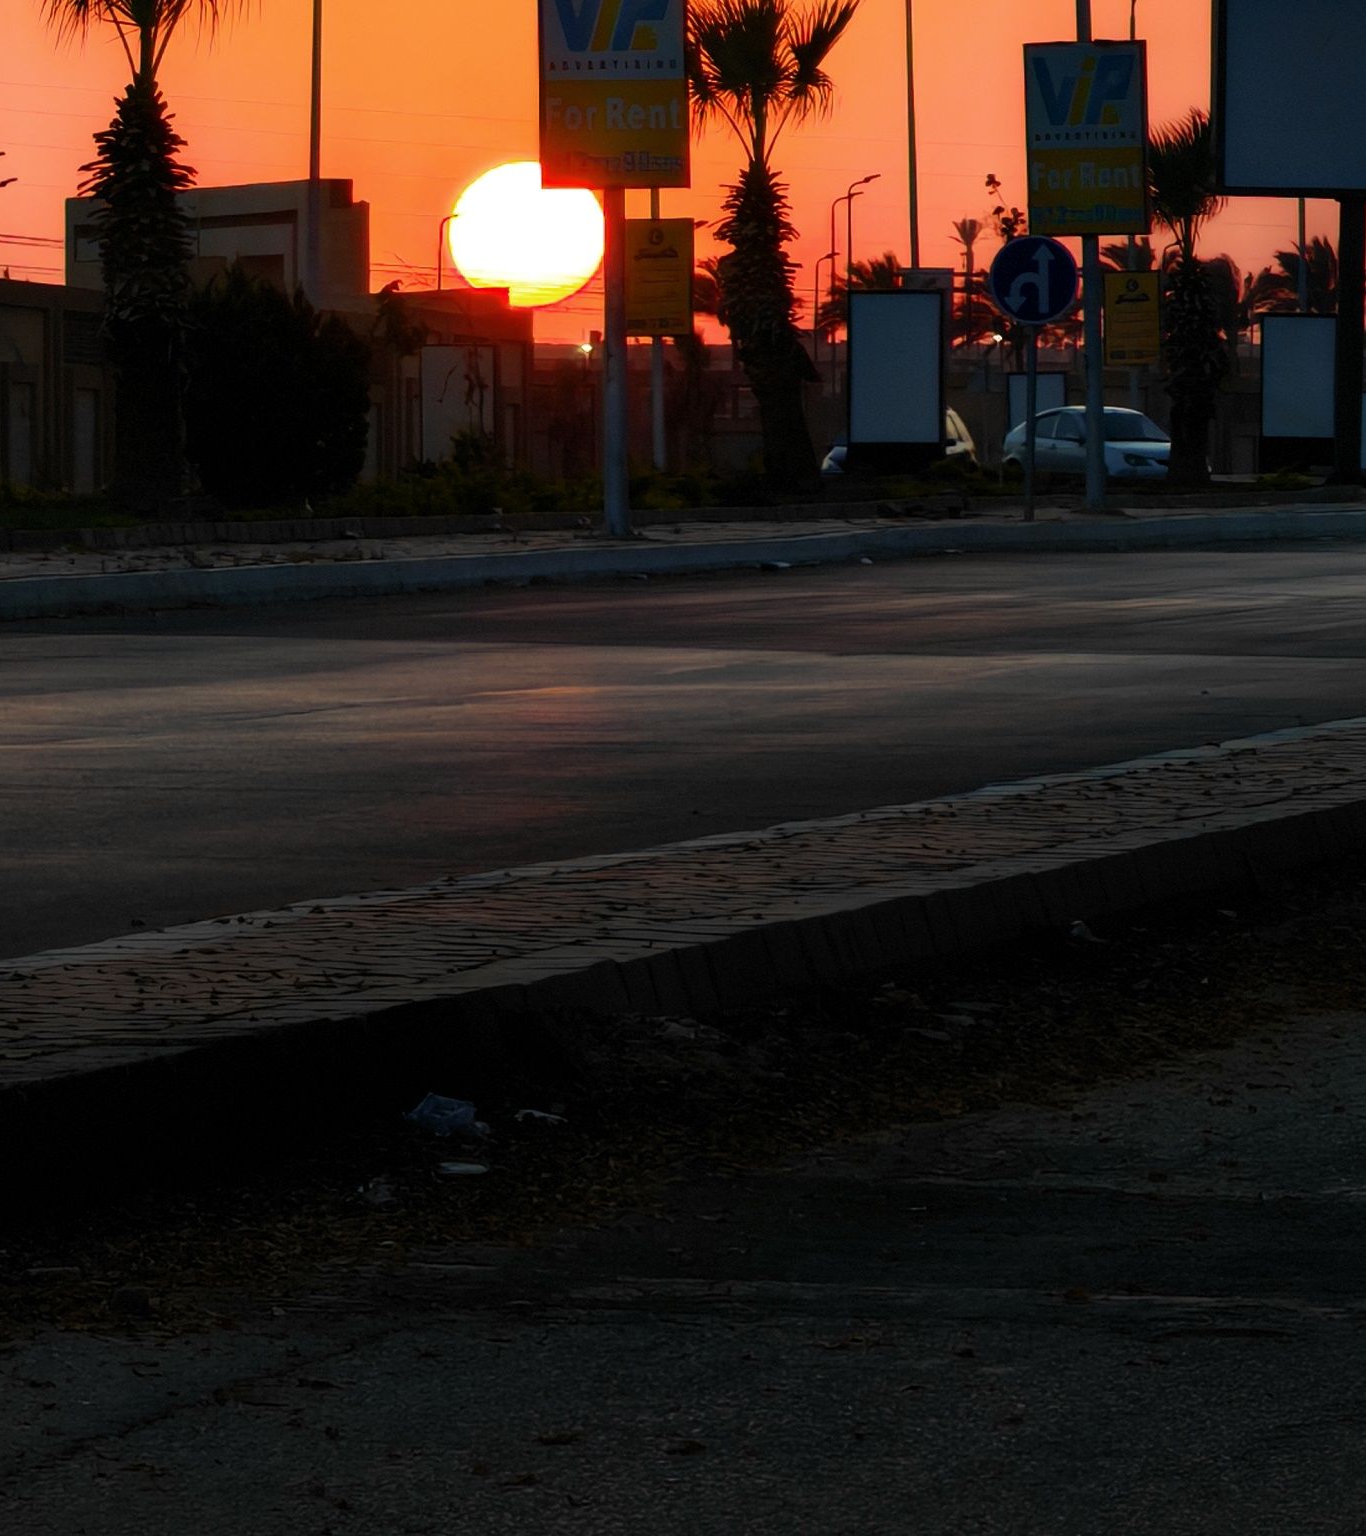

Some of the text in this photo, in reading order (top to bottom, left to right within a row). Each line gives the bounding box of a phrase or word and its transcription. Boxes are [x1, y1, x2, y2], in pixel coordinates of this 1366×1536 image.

[546, 96, 682, 131] For Rent
[1032, 161, 1140, 191] For Rent
